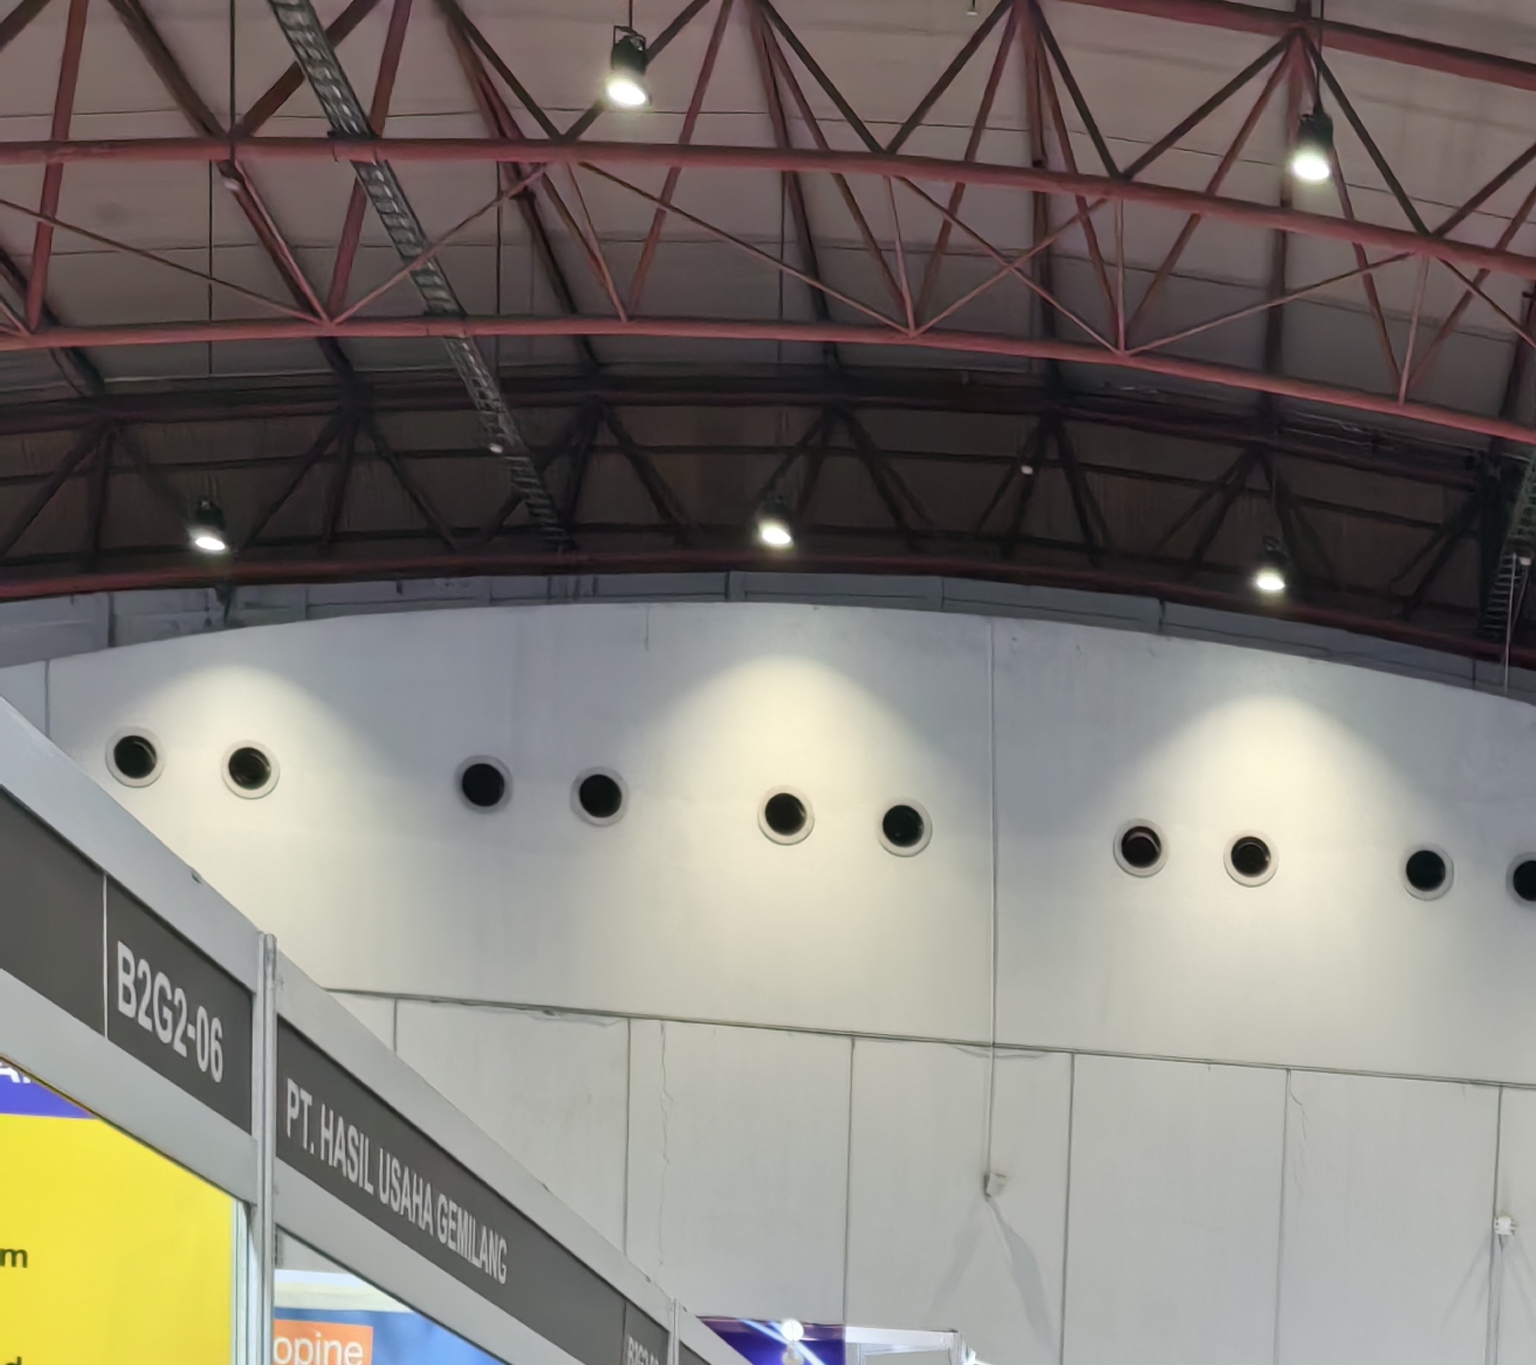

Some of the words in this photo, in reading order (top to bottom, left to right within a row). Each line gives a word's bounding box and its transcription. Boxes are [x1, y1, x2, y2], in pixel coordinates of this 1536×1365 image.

[117, 940, 224, 1082] B2G2-06
[286, 1078, 314, 1155] PT.
[320, 1103, 373, 1196] HASIL
[378, 1147, 433, 1236] USAHA
[437, 1193, 508, 1284] GEMILANG
